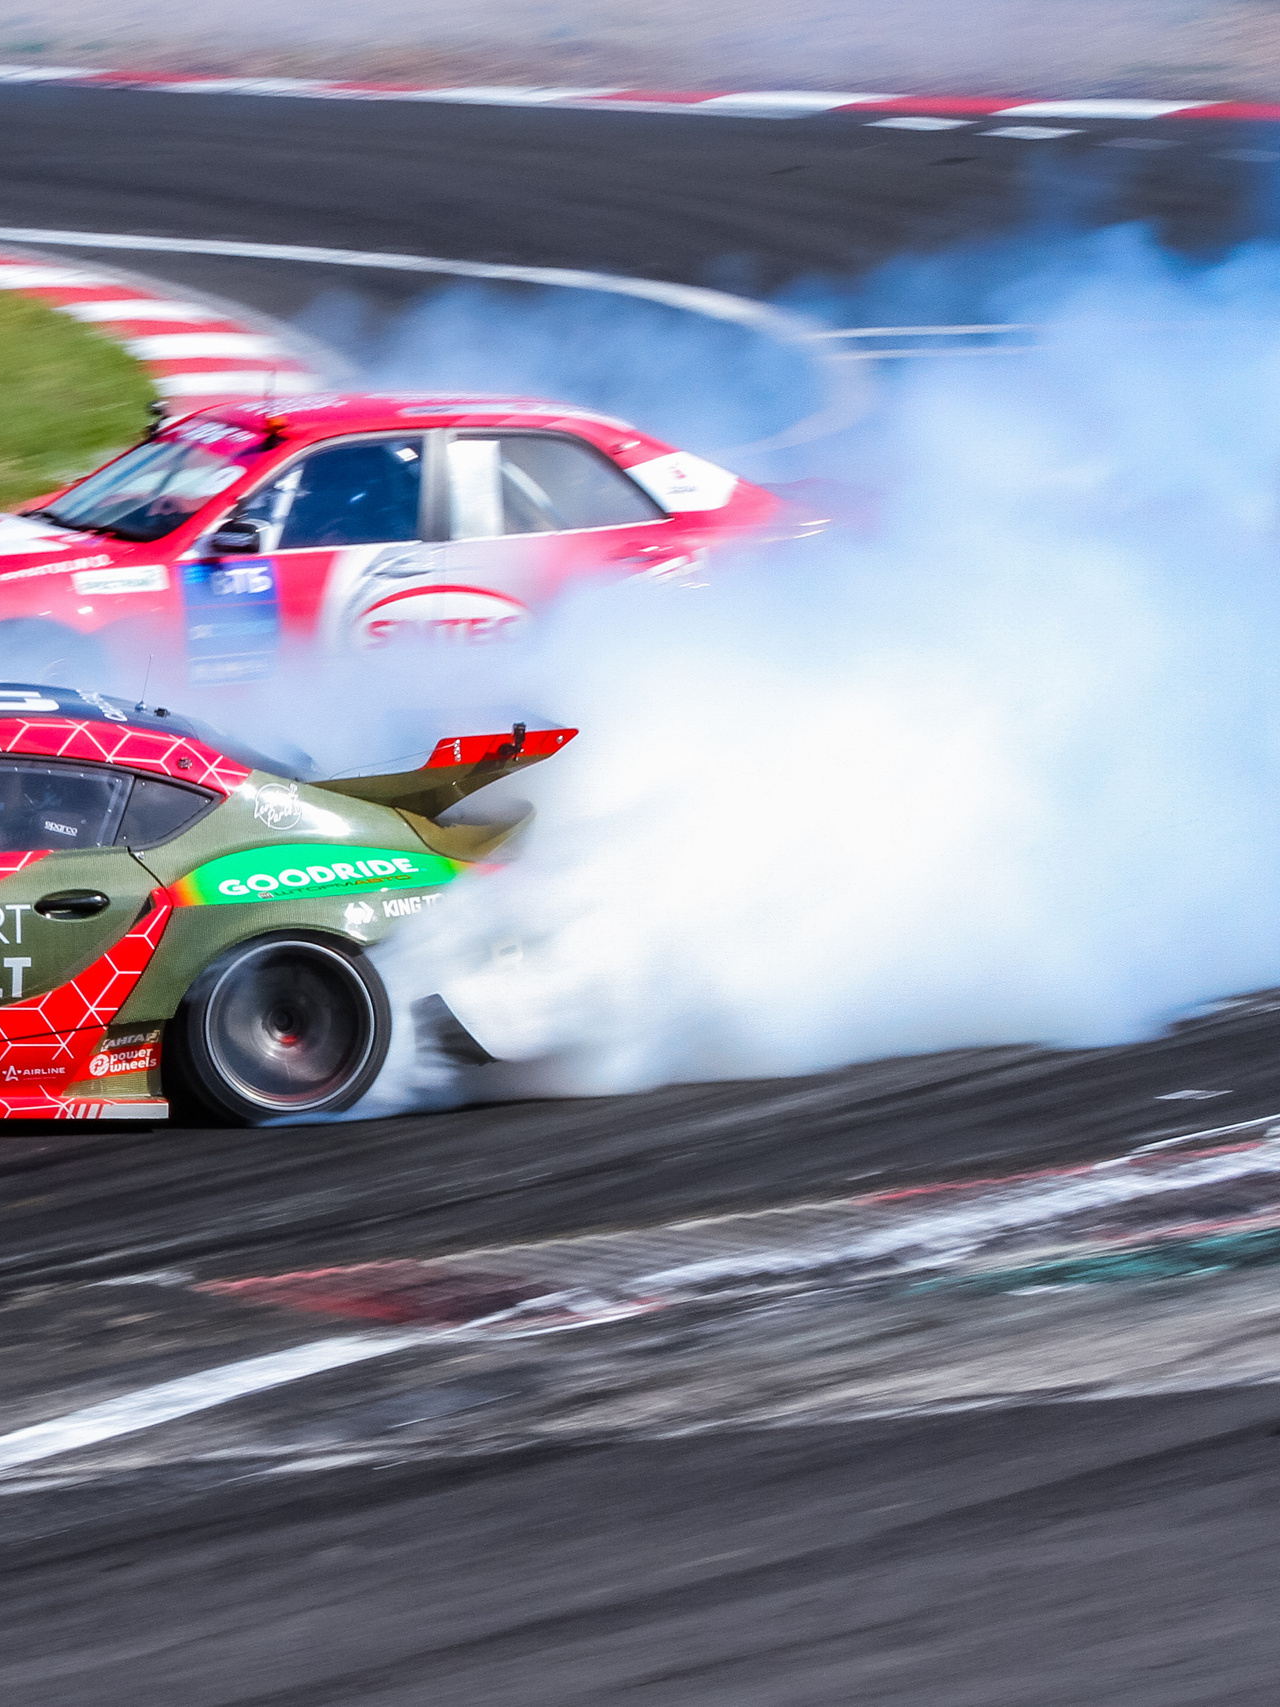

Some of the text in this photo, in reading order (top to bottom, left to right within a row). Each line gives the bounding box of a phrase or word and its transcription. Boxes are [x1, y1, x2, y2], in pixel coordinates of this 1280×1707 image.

[218, 858, 419, 896] GOODRIDE
[382, 899, 424, 918] KING
[110, 1048, 153, 1066] power
[110, 1057, 157, 1073] wheels
[22, 1067, 66, 1075] AIRLINE
